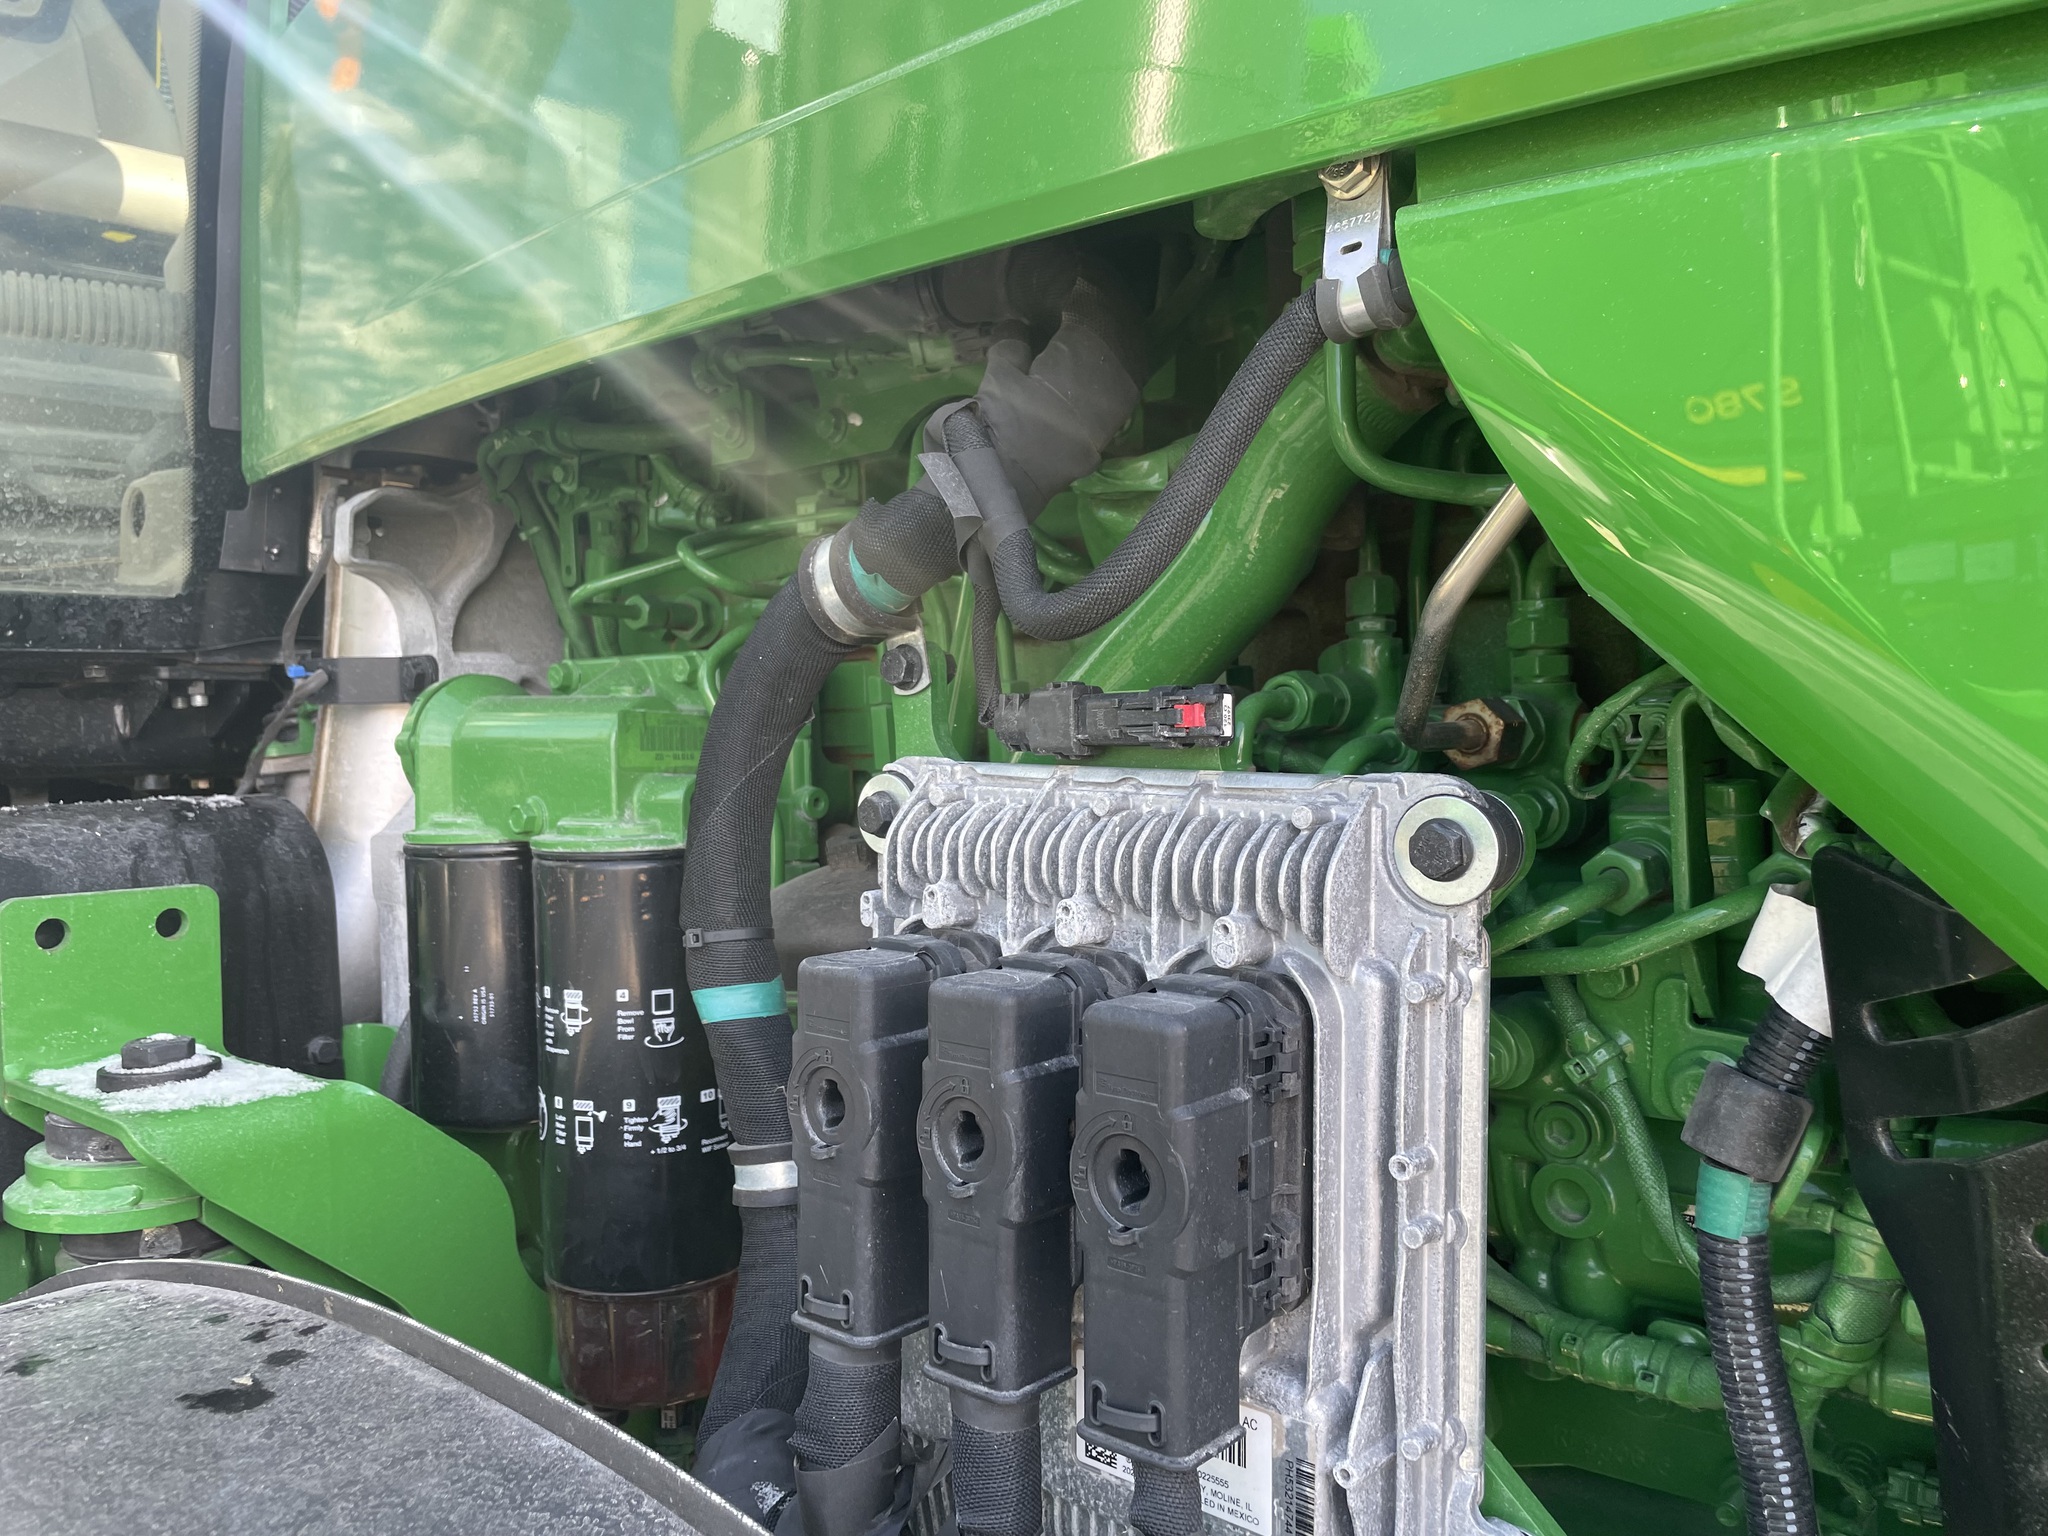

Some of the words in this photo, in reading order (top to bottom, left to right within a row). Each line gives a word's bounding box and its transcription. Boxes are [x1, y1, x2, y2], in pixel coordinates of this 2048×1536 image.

[616, 1009, 645, 1017] Remove
[616, 1017, 635, 1025] Bowl
[616, 1025, 636, 1033] From
[616, 1033, 636, 1041] Filter
[623, 1116, 649, 1125] Tighten
[623, 1125, 645, 1133] Firmly
[623, 1132, 634, 1141] By
[623, 1140, 643, 1148] Hand
[1241, 1416, 1258, 1431] AC
[1210, 1488, 1244, 1511] MOLINE,
[1245, 1502, 1253, 1512] IL
[1216, 1502, 1226, 1513] IN
[1227, 1507, 1261, 1526] MEXICO
